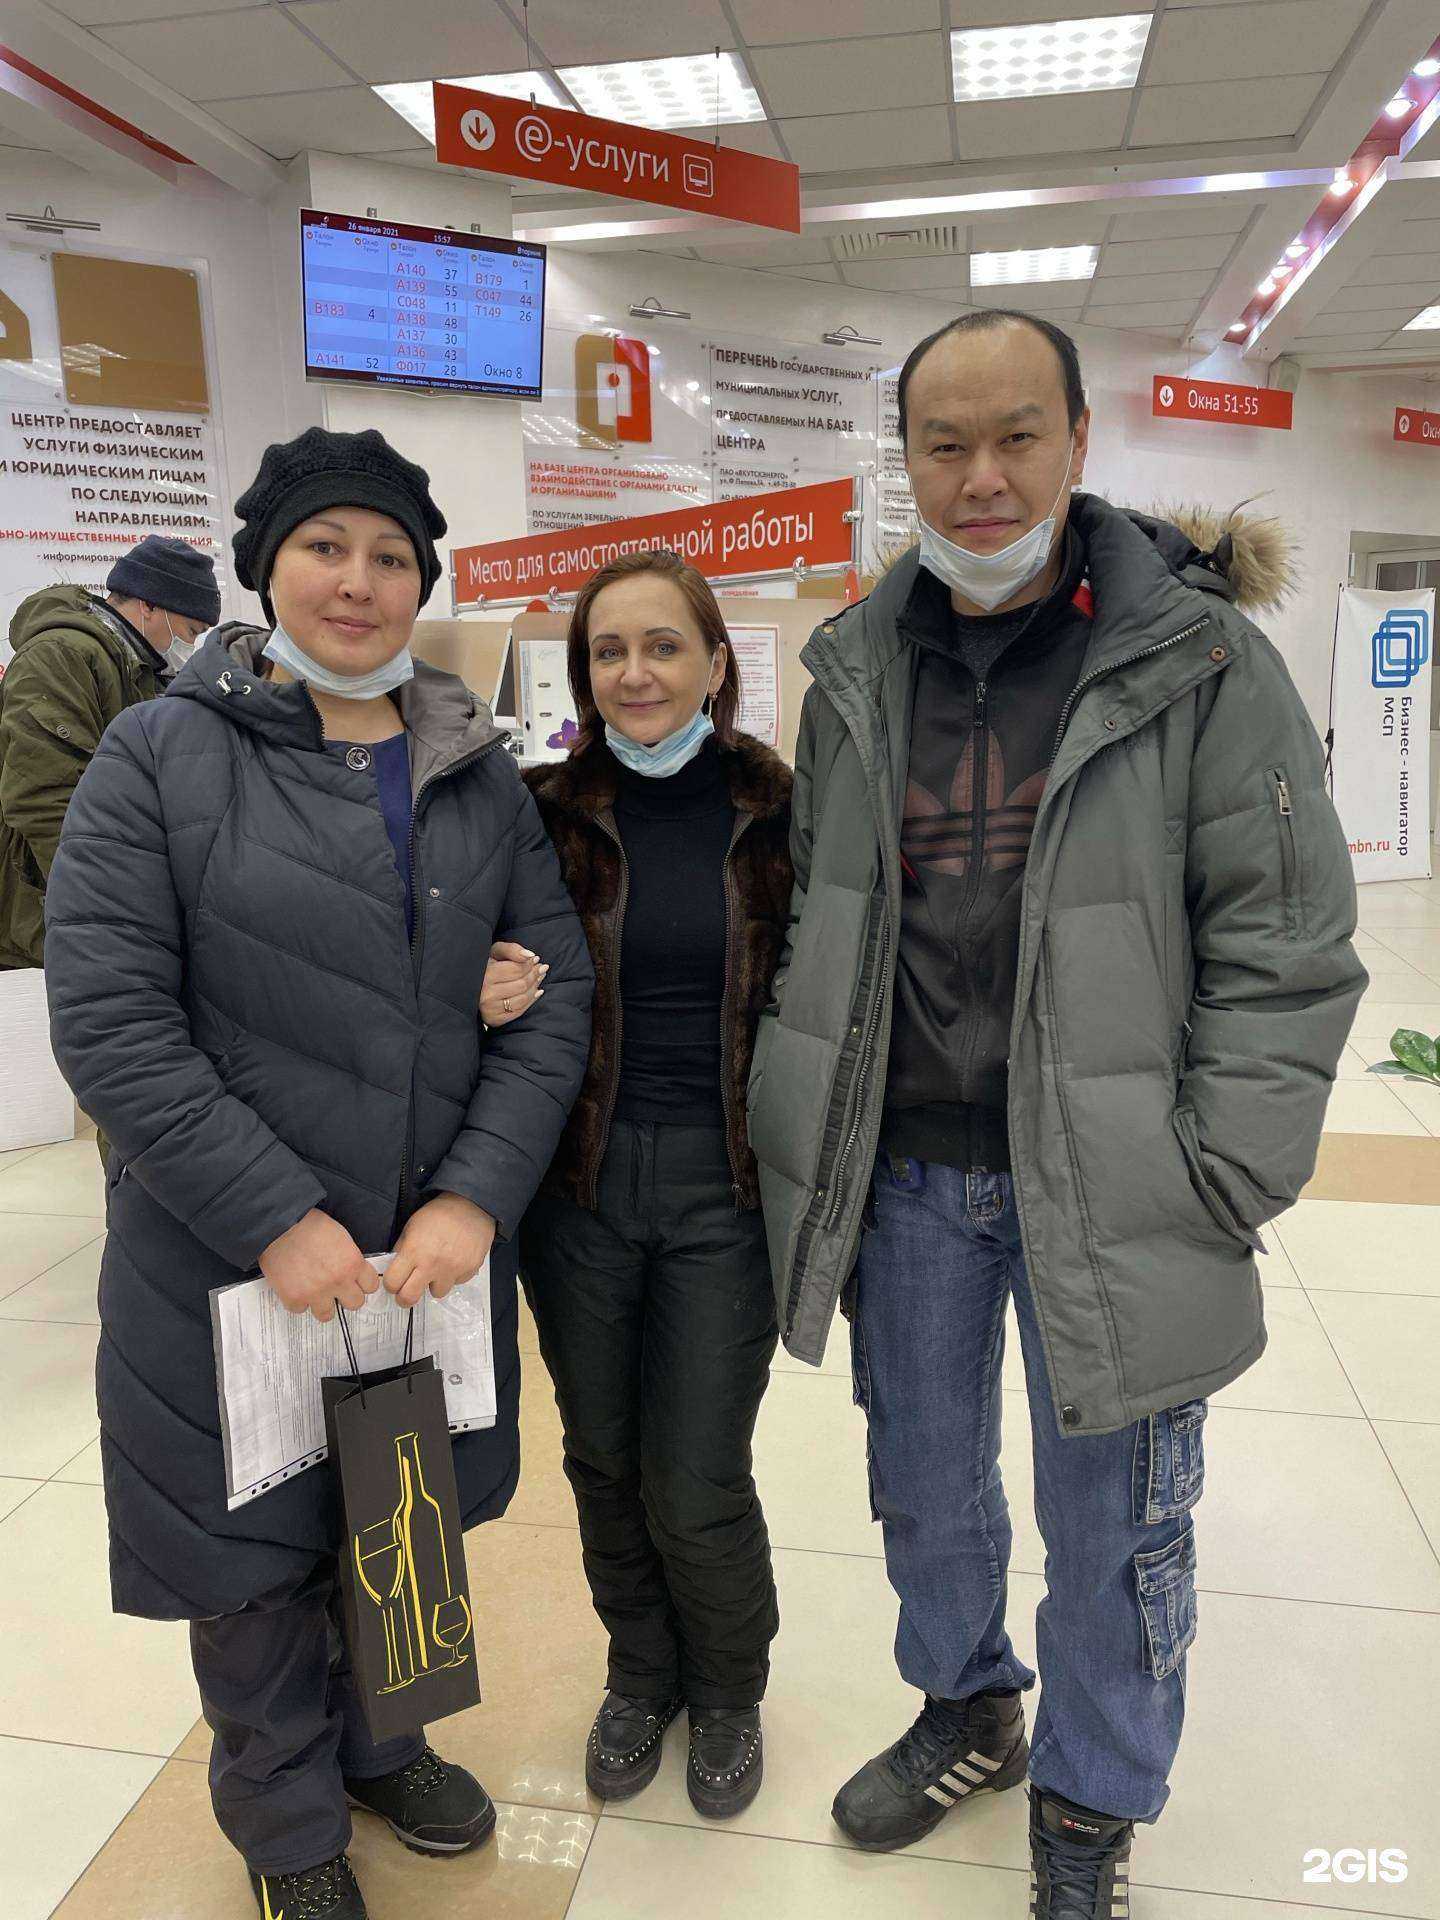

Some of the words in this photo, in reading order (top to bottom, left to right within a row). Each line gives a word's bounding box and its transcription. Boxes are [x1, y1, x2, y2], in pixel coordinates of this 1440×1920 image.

[348, 222, 357, 230] 26
[358, 225, 382, 234] января
[383, 227, 399, 236] 2021
[434, 234, 451, 244] 15:57
[396, 263, 426, 277] А140
[444, 269, 458, 280] 37
[396, 279, 426, 293] А139
[444, 286, 458, 297] 55
[475, 273, 502, 286] В179
[523, 280, 529, 289] 1
[397, 296, 426, 309] С048
[445, 302, 457, 312] 11
[475, 290, 502, 301] С047
[519, 295, 532, 306] 44
[315, 302, 345, 316] В183
[368, 309, 375, 320] 4
[474, 305, 501, 318] Т149
[519, 311, 532, 322] 26
[396, 312, 426, 325] А138
[444, 318, 458, 329] 48
[396, 328, 426, 342] А137
[444, 334, 458, 345] 30
[315, 353, 345, 366] А141
[366, 358, 379, 369] 52
[396, 345, 426, 358] А136
[444, 350, 458, 361] 43
[396, 361, 426, 374] Ф017
[444, 366, 458, 377] 28
[483, 364, 513, 378] Окно
[516, 368, 523, 379] 8
[716, 348, 778, 369] ПЕРЕЧЕНЬ
[780, 360, 863, 380] ГОСУДАРСТВЕННЫХ
[716, 381, 800, 400] МУНИЦИПАЛЬНЫХ
[801, 388, 842, 406] УСЛУГ,
[1188, 389, 1220, 412] Окна
[1224, 394, 1258, 415] 51-55
[11, 412, 65, 428] ЦЕНТР
[69, 417, 202, 439] ПРЕДОСТАВЛЯЕТ
[716, 409, 806, 427] ПРЕДОСТАВЛЯЕМЫХ
[808, 416, 824, 430] НА
[826, 419, 854, 433] БАЗЕ
[24, 437, 89, 454] УСЛУГИ
[93, 442, 204, 461] ФИЗИЧЕСКИМ
[717, 435, 765, 451] ЦЕНТРА
[12, 460, 145, 480] ЮРИДИЧЕСКИМ
[148, 470, 206, 484] ЛИЦАМ
[530, 462, 543, 471] НА
[545, 463, 565, 473] БАЗЕ
[567, 465, 600, 476] ЦЕНТРА
[601, 468, 669, 480] ОРГАНИЗОВАНО
[720, 468, 734, 476] ПАО
[530, 474, 612, 488] ВЗАИМОДЕЙСТВИЕ
[613, 479, 619, 488] С
[620, 480, 664, 493] ОРГАНАМИ
[71, 487, 95, 500] ПО
[99, 489, 208, 506] СЛЕДУЮЩИМ
[531, 486, 538, 494] И
[538, 487, 617, 499] ОРГАНИЗАЦИЯМИ
[75, 511, 210, 528] НАПРАВЛЕНИЯМ:
[532, 510, 545, 519] ПО
[545, 510, 583, 521] УСЛУГАМ
[469, 556, 512, 586] Место
[516, 552, 544, 585] для
[722, 509, 814, 562] работы
[1382, 696, 1395, 737] МСП
[1400, 696, 1412, 756] Бизнес
[1397, 769, 1410, 857] навигатор
